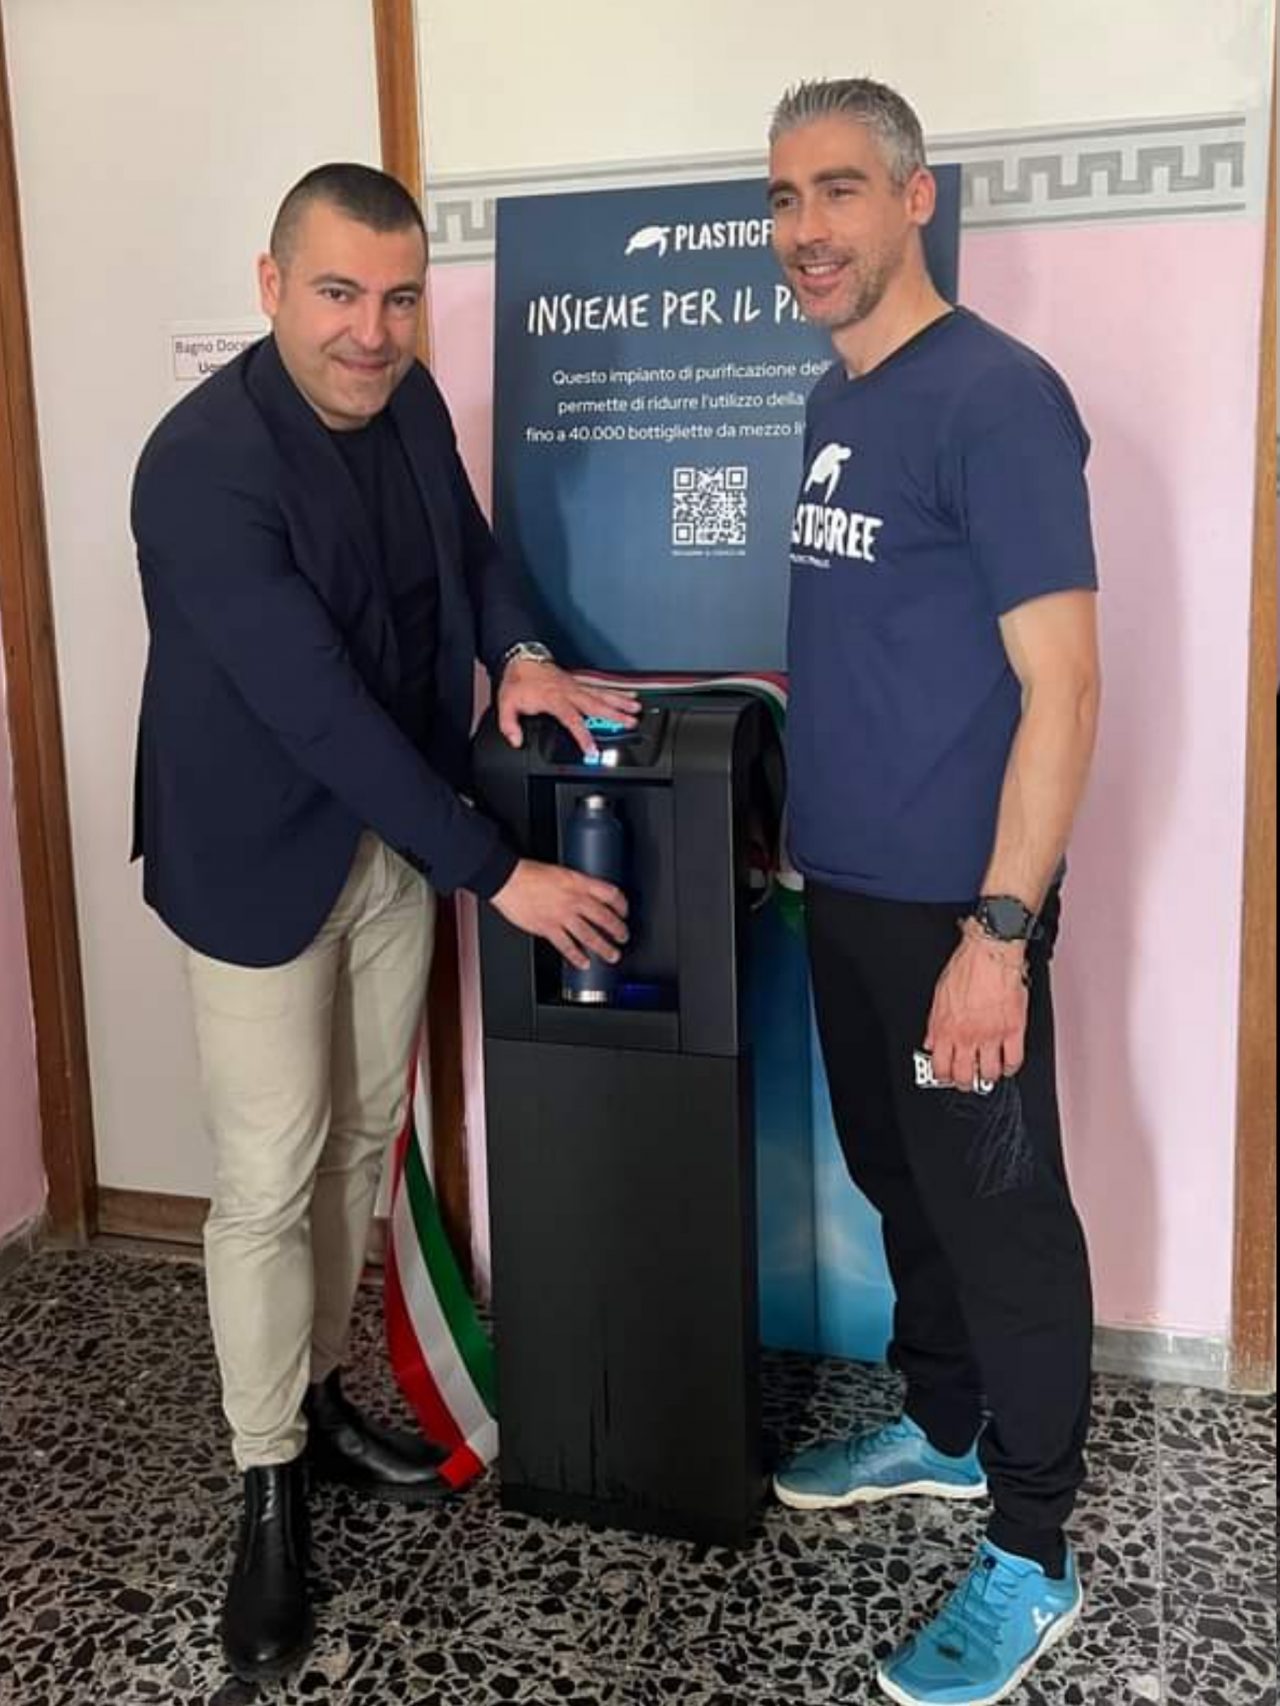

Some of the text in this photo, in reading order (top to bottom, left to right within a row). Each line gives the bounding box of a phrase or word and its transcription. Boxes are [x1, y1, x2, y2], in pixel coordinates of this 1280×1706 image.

[527, 283, 806, 336] INSIEME PER IL PI
[552, 370, 607, 385] Questo
[609, 368, 676, 385] impianto
[678, 366, 694, 380] di
[695, 362, 797, 382] purificazione
[558, 398, 628, 416] permette
[630, 397, 645, 412] di
[647, 395, 698, 411] ridurre
[526, 427, 554, 442] fino
[556, 429, 566, 440] a
[568, 426, 625, 441] 40.000
[627, 422, 713, 443] bottigliette
[716, 421, 736, 438] da
[738, 423, 791, 436] mezzo
